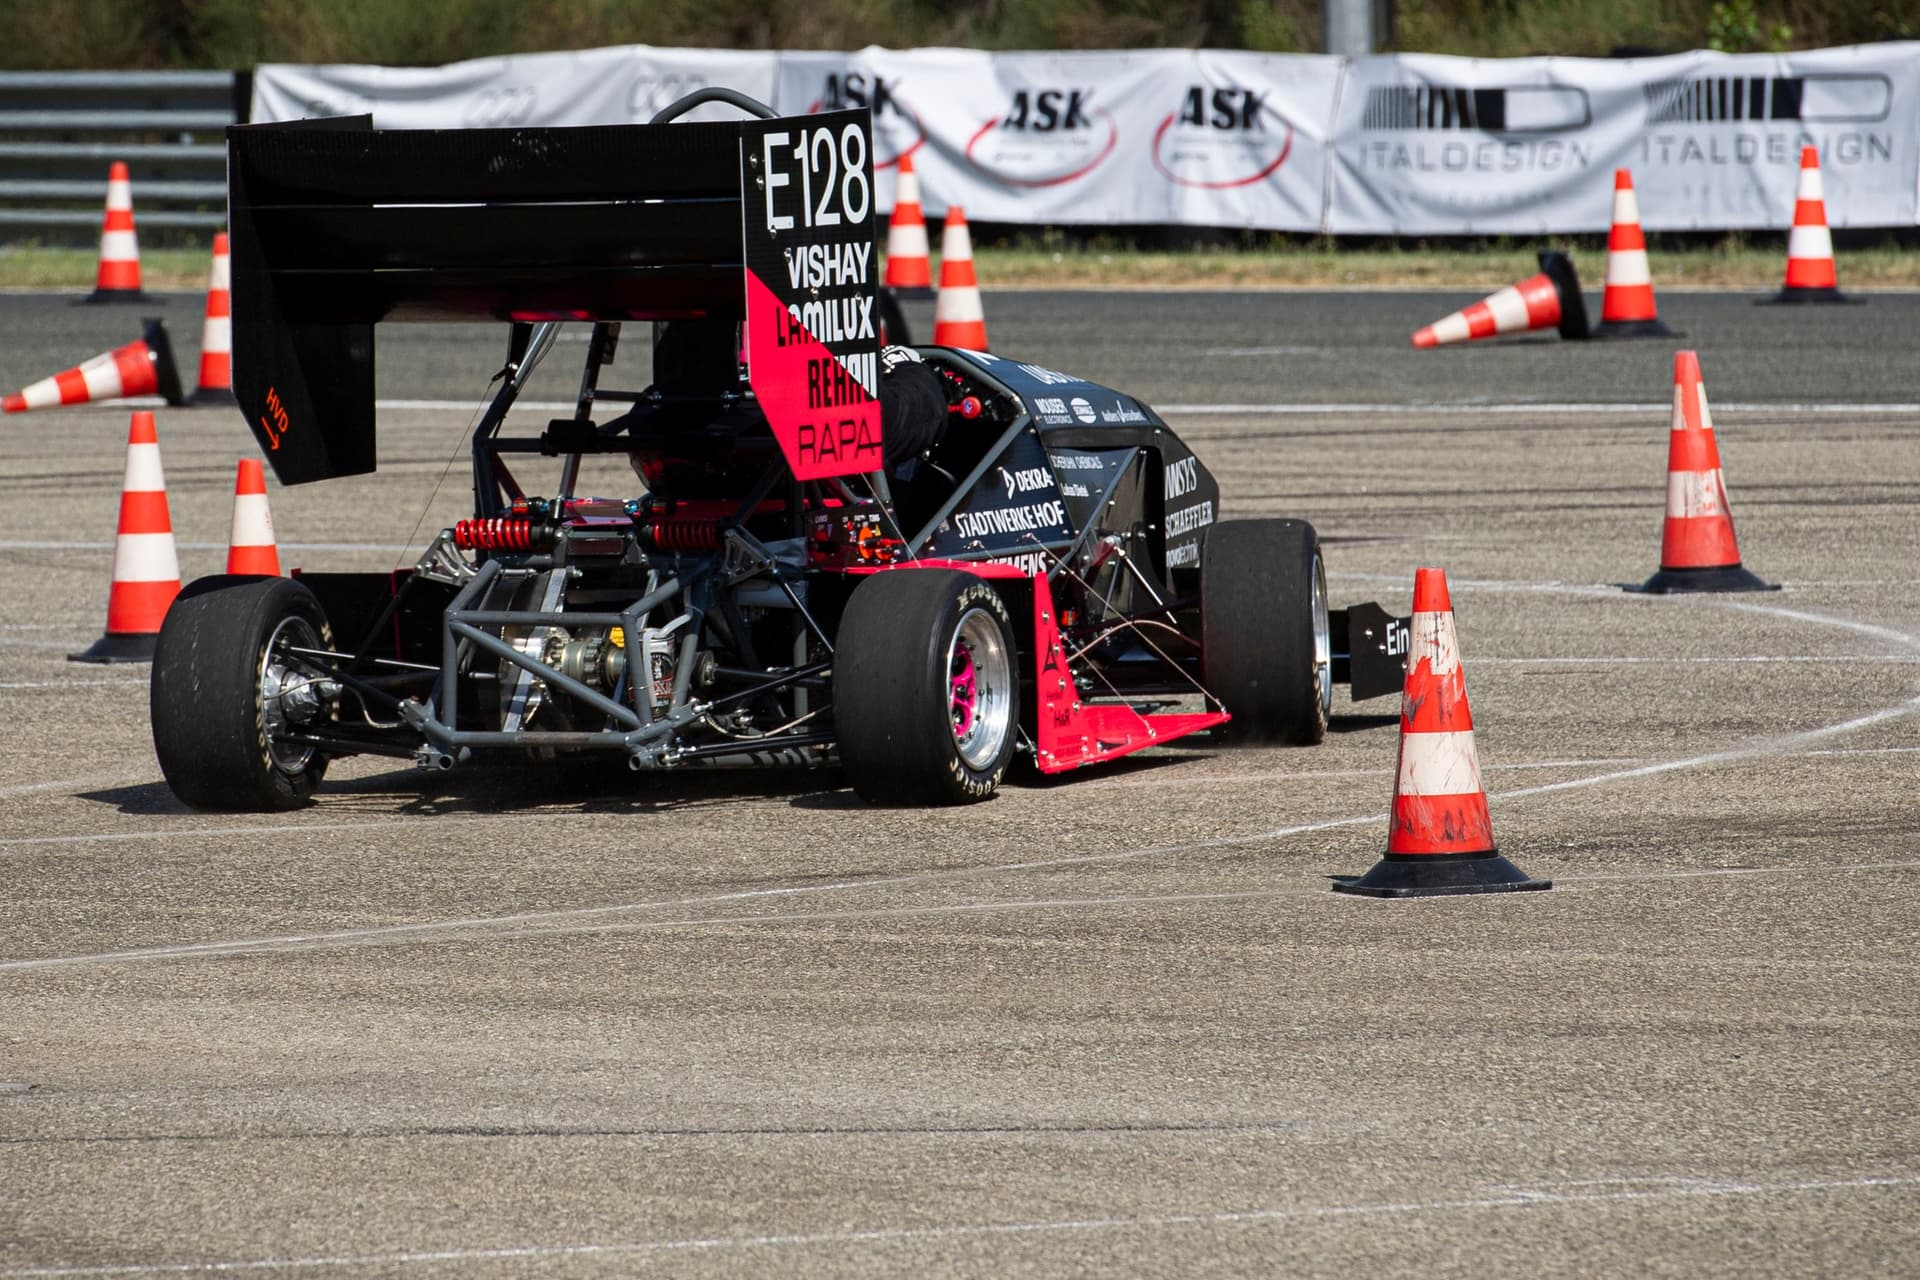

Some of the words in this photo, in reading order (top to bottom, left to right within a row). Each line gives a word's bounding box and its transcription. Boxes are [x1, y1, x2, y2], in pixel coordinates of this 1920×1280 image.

[822, 72, 901, 116] ASK
[1004, 88, 1093, 132] ASK
[1179, 86, 1268, 131] ASK
[763, 123, 870, 231] E128
[1359, 140, 1592, 174] ITALDESIGN
[784, 241, 872, 290] VISHAY
[776, 296, 876, 347] LAMILUX
[808, 352, 878, 409] REHAU
[798, 417, 882, 465] RAPA
[1015, 466, 1055, 492] DEKRA
[954, 506, 1036, 539] STADTWERKE
[1032, 500, 1064, 528] HOF
[1165, 500, 1214, 540] SCHAEFFLER
